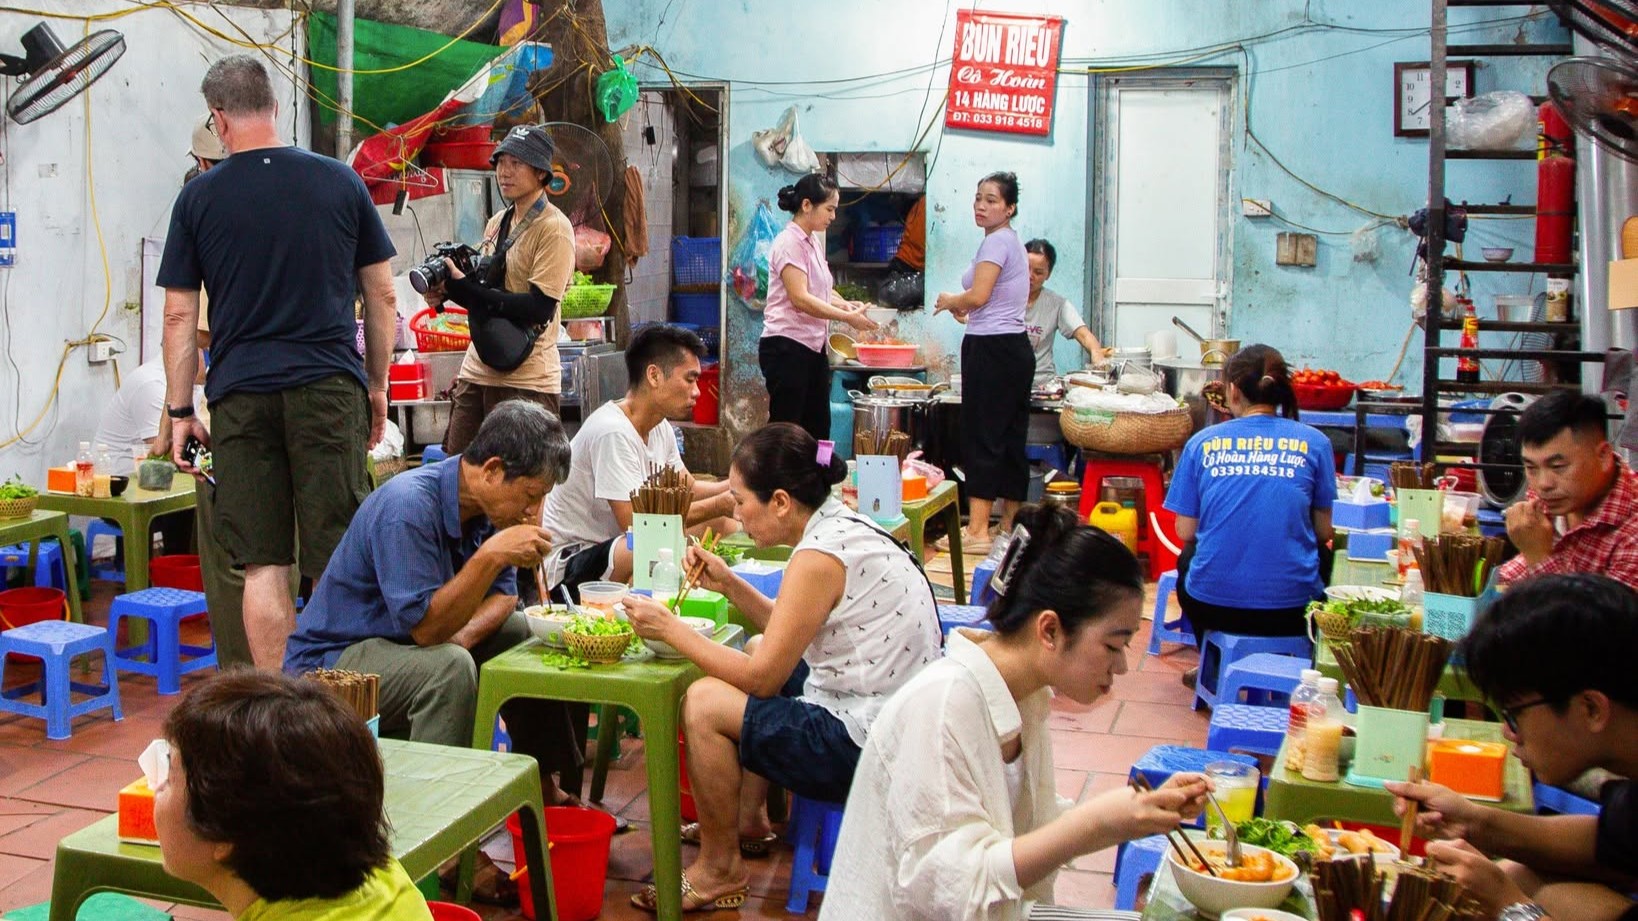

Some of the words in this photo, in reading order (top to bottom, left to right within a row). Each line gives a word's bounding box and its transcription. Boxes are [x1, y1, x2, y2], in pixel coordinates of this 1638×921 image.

[957, 65, 982, 84] Cô
[990, 68, 1047, 90] Hoàn
[955, 90, 970, 107] 14
[973, 89, 1009, 111] HÀNG
[953, 111, 970, 122] ĐT:
[973, 113, 992, 124] 033
[995, 115, 1015, 126] 918
[1016, 117, 1043, 128] 4518
[1237, 435, 1274, 451] RIÊU
[1278, 437, 1309, 454] CUA
[1202, 452, 1215, 468] Cô
[1216, 450, 1246, 465] Hoàn
[1247, 451, 1279, 466] Hàng
[1211, 465, 1294, 477] 0339184518
